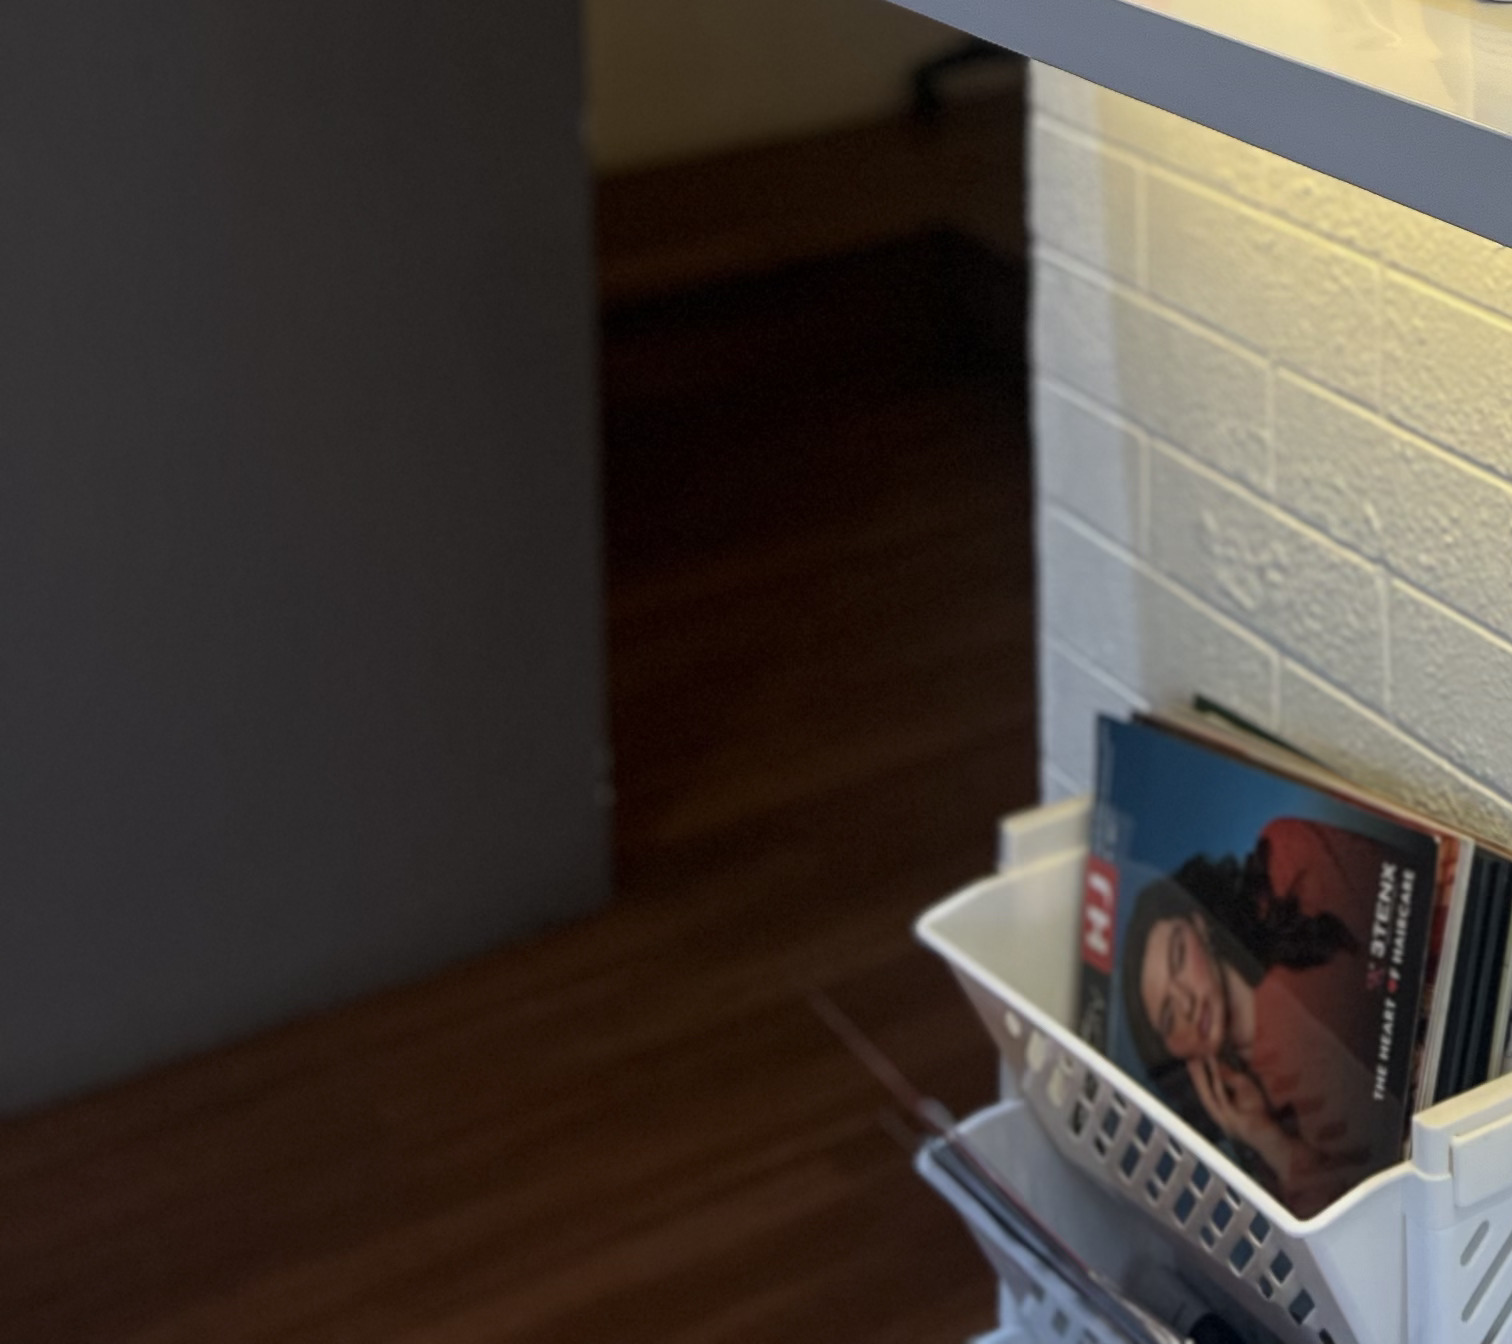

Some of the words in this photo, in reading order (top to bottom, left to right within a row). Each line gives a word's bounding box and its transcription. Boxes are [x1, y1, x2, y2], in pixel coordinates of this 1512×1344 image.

[1389, 867, 1417, 964] HAIRCARE
[1377, 997, 1398, 1061] HEART
[1372, 1066, 1388, 1102] THE
